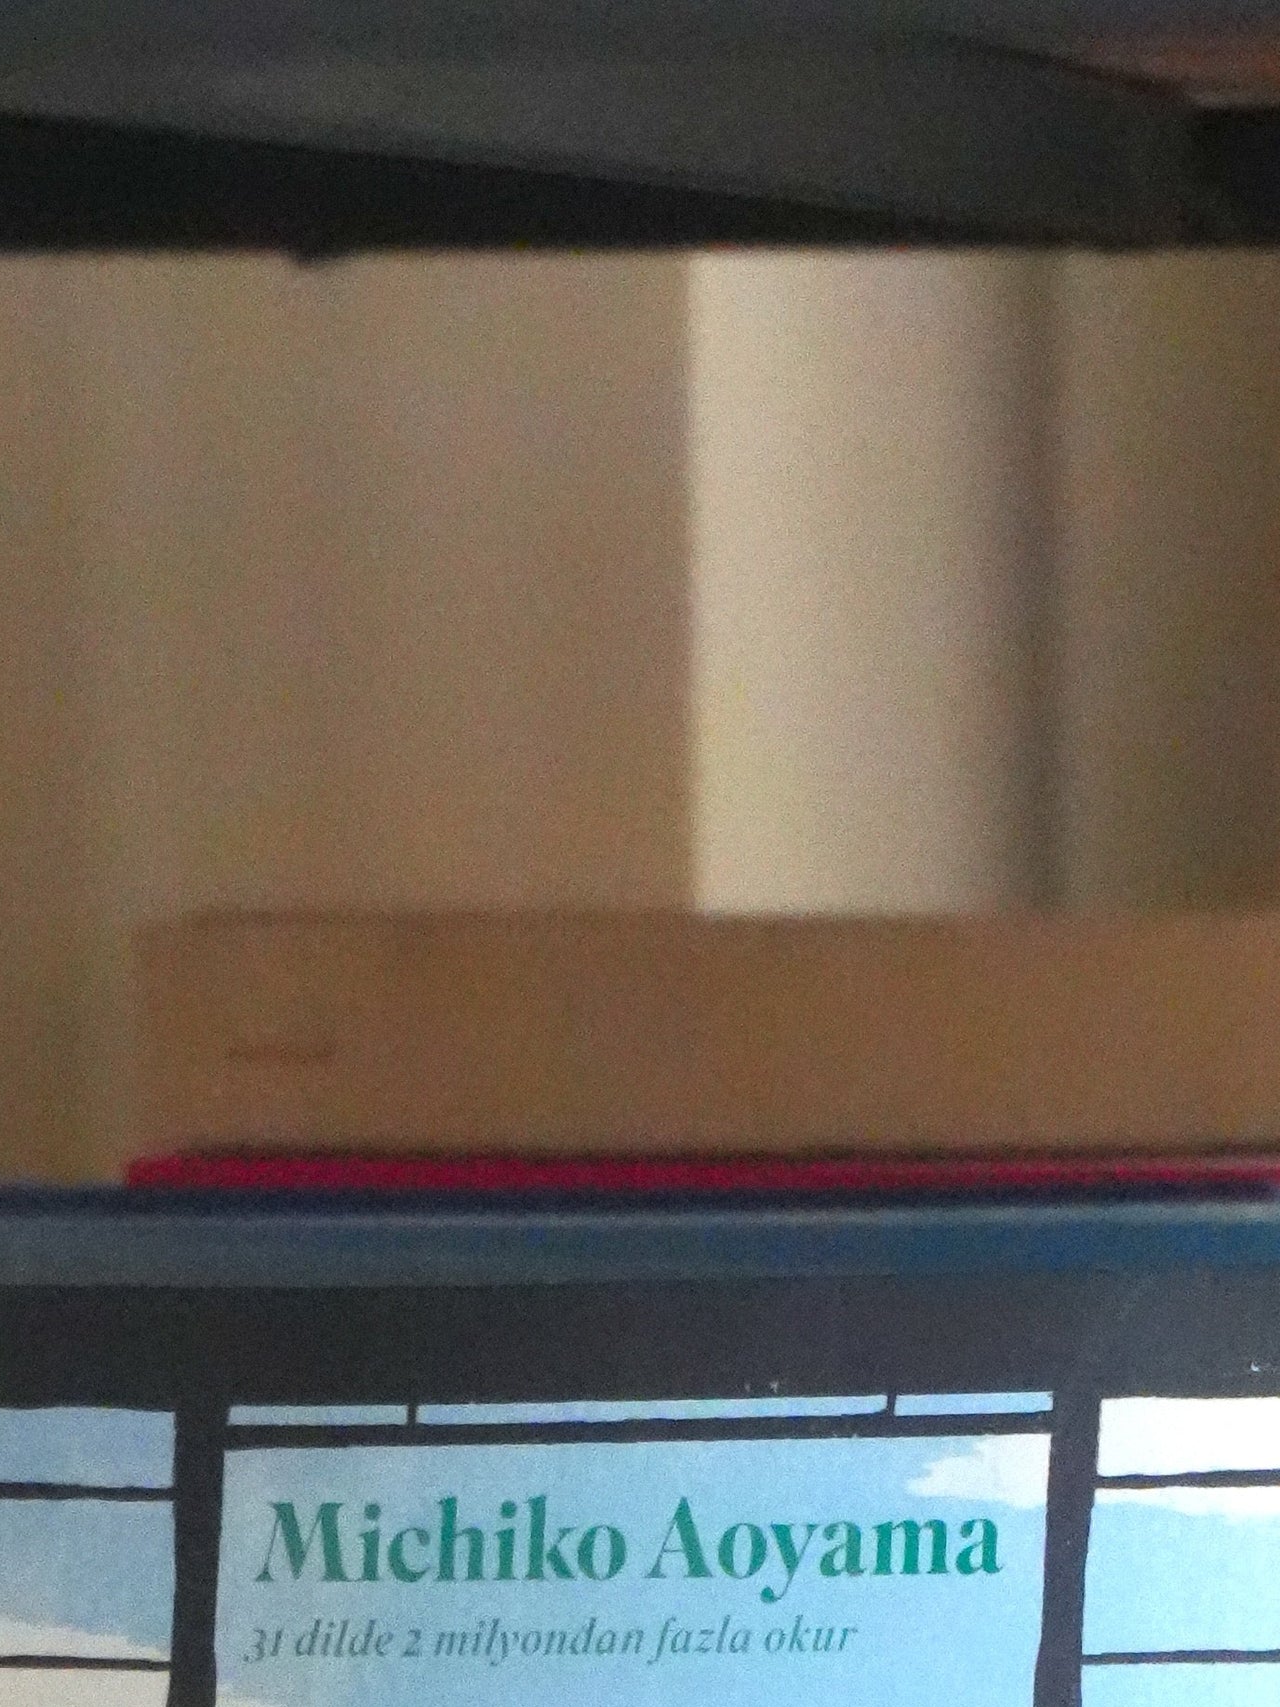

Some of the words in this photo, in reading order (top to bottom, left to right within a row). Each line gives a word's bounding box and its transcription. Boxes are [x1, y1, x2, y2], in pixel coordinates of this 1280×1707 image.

[253, 1494, 627, 1584] Michiko
[647, 1495, 1003, 1602] Aoyama
[243, 1629, 283, 1662] 31
[295, 1619, 394, 1657] dilde
[403, 1629, 421, 1657] 2
[433, 1617, 642, 1665] milyondan
[647, 1615, 751, 1665] fazla
[764, 1615, 857, 1652] okur
